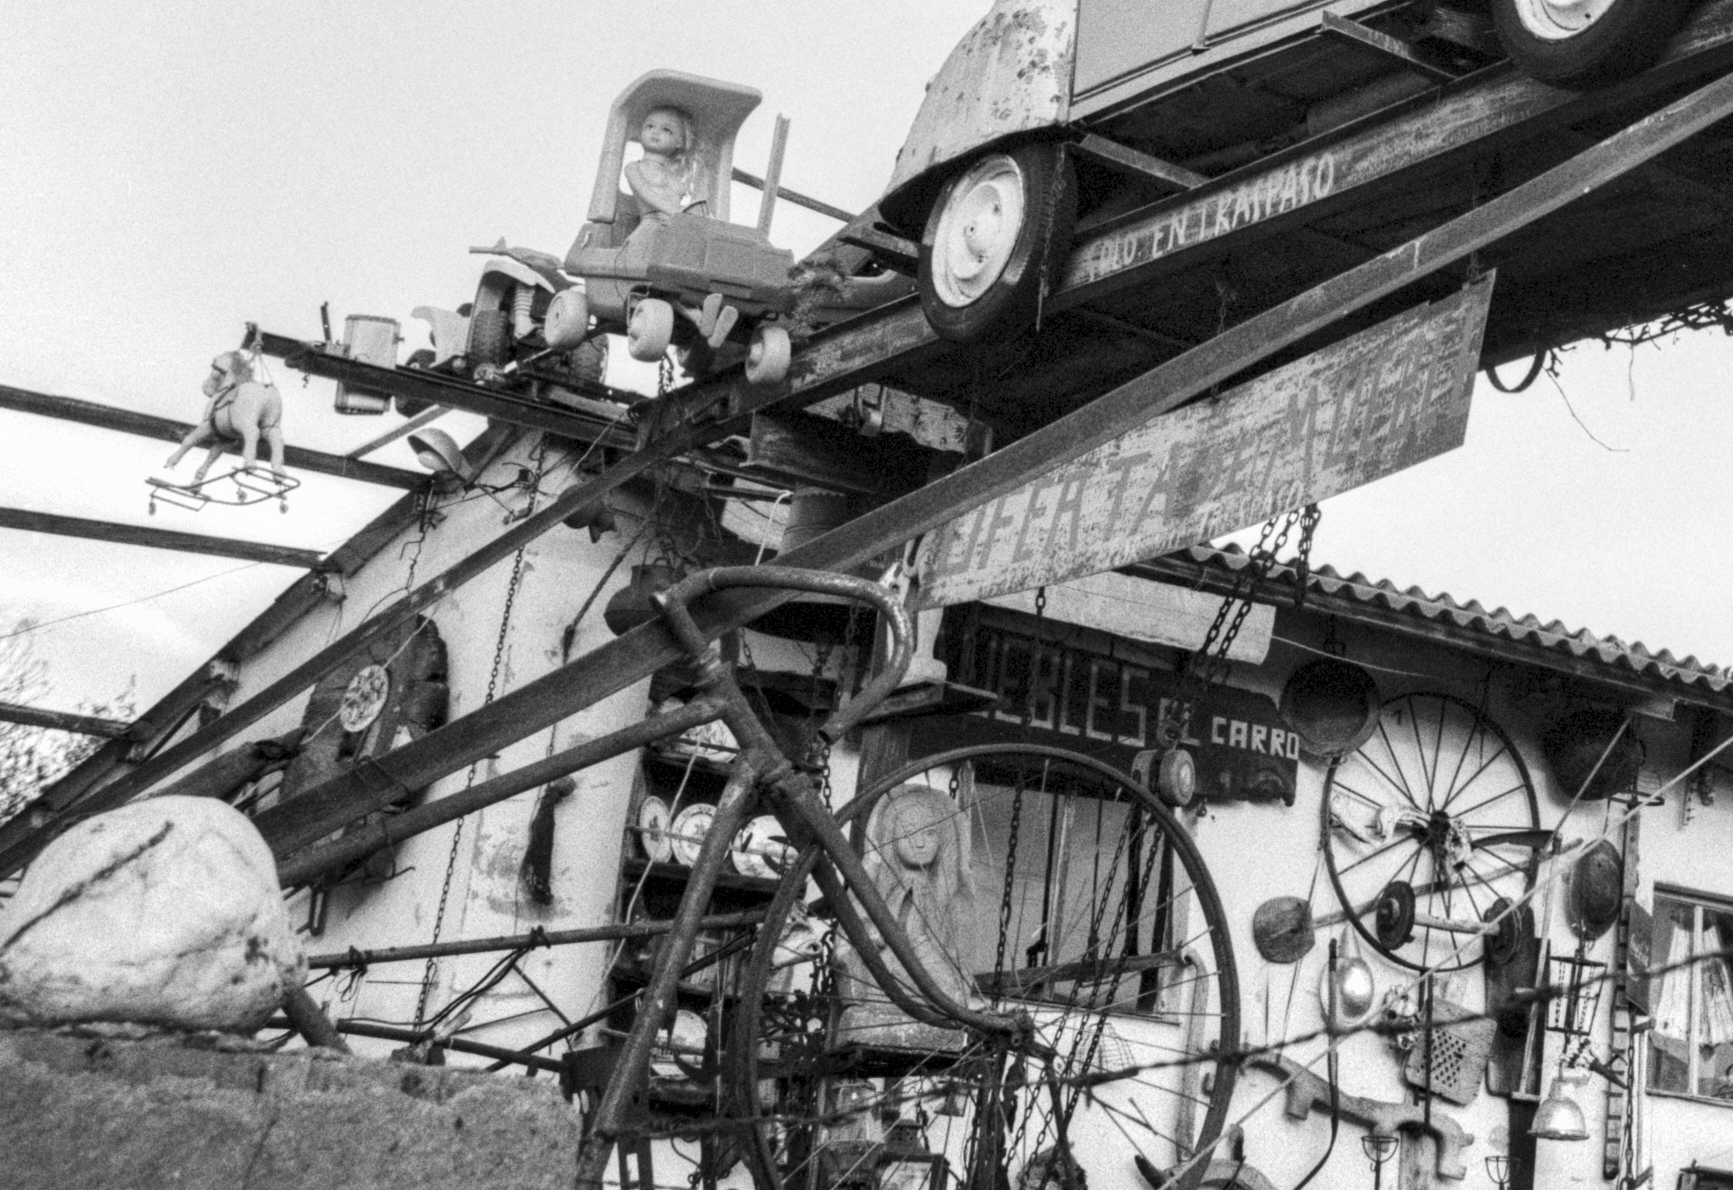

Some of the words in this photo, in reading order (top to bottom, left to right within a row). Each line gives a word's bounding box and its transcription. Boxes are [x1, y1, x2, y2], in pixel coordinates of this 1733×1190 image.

[1152, 206, 1189, 261] EN
[1194, 151, 1335, 241] TRASPASO
[942, 630, 1146, 748] UEBLES
[1210, 715, 1300, 761] CARRO
